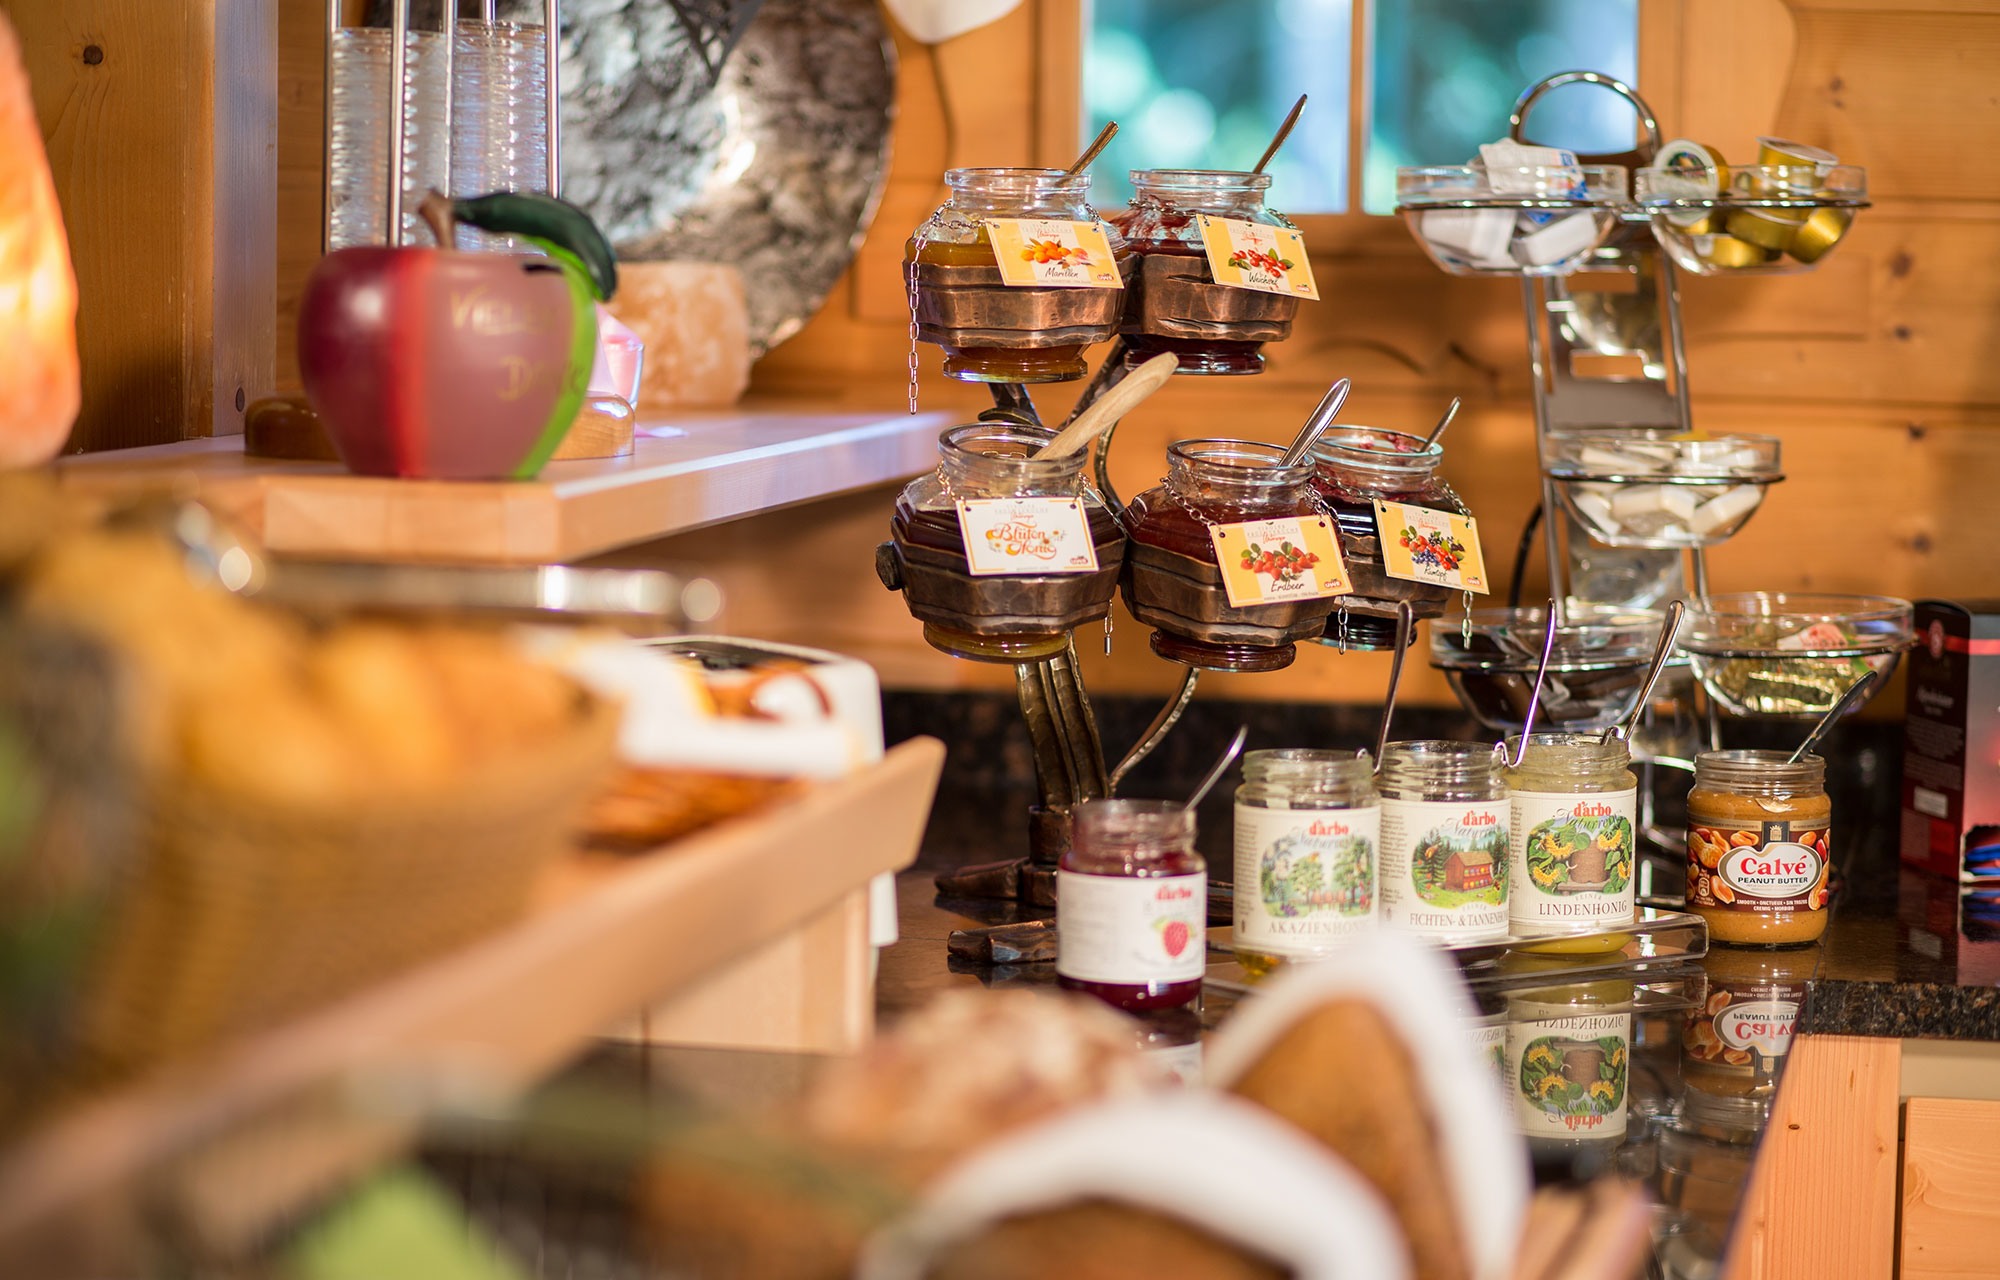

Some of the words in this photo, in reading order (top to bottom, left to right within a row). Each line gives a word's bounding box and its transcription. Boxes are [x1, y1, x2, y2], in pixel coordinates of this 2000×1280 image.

[1045, 267, 1079, 278] Marillen
[1271, 579, 1304, 592] Erdbeer
[1574, 801, 1612, 817] d'arbo
[1740, 855, 1808, 876] Calvé
[1738, 877, 1776, 885] PEANUT
[1778, 876, 1808, 885] BUTTER
[1539, 900, 1627, 916] LINDENHONIG
[1410, 913, 1456, 927] FICHTEN-
[1458, 912, 1466, 927] &
